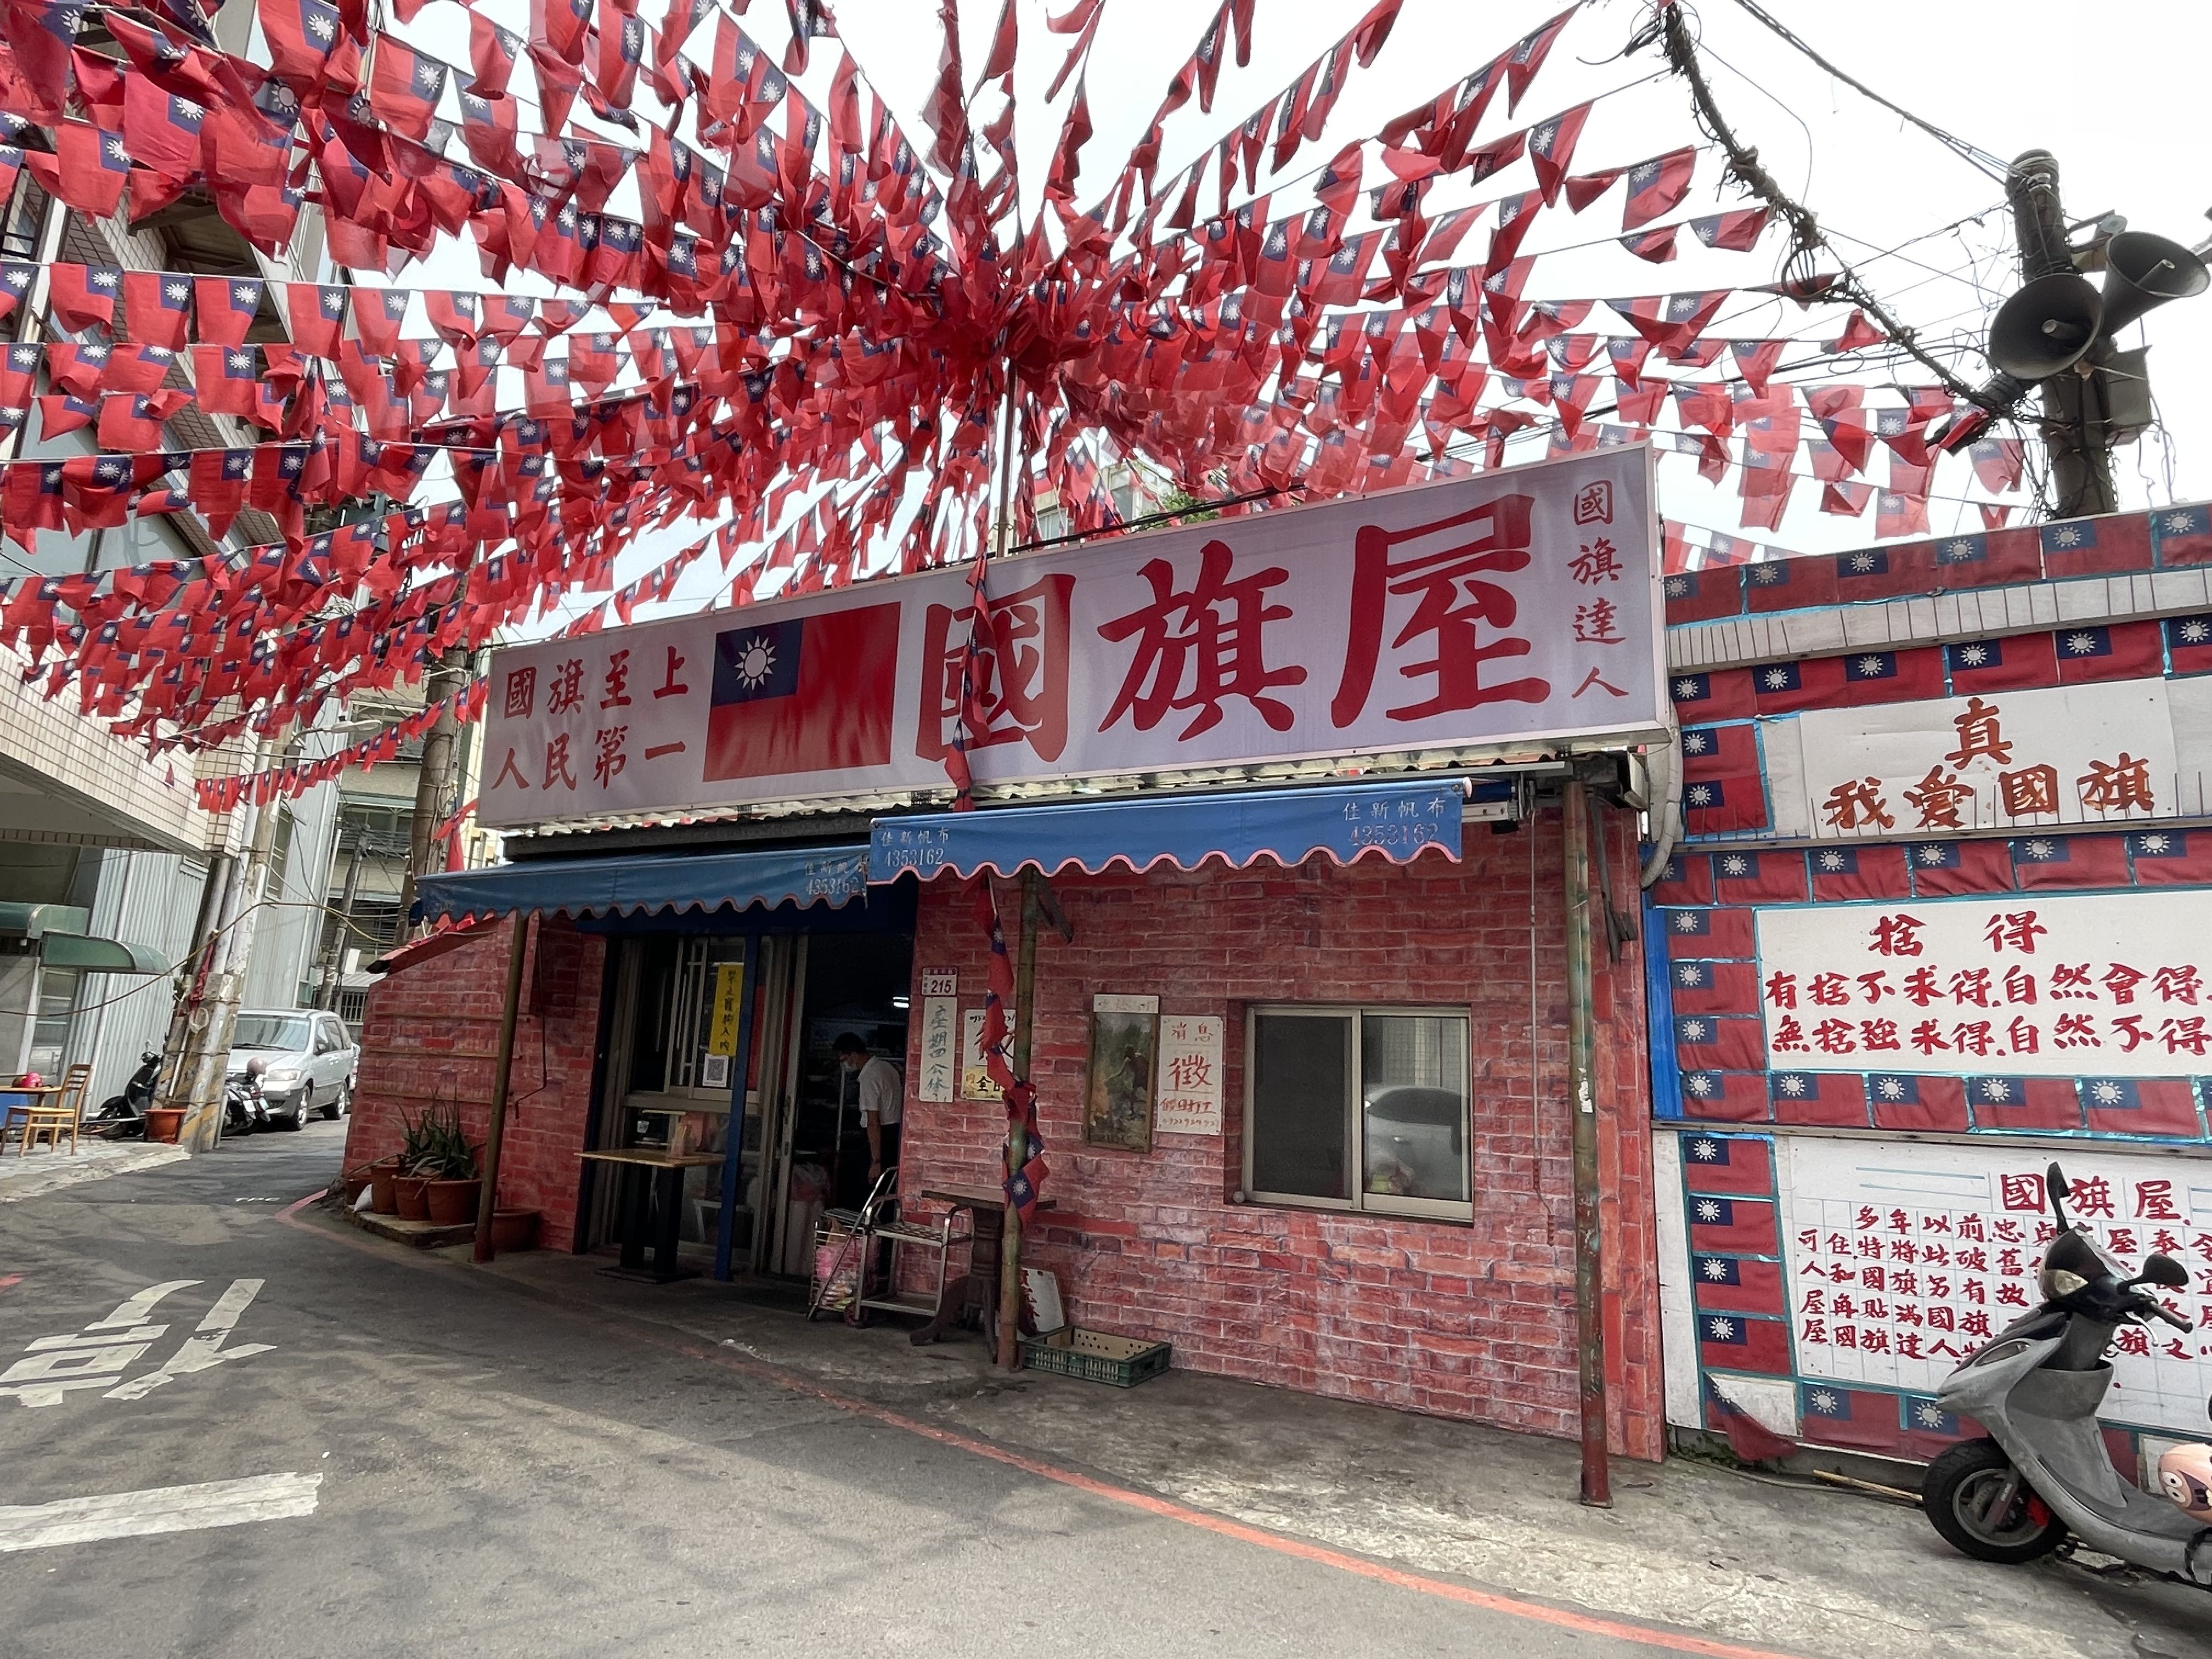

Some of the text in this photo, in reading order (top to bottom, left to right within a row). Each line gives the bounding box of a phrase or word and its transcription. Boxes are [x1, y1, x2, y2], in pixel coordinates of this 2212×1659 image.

[1567, 479, 1629, 698] 國旗達人
[915, 493, 1551, 764] 國旗屋
[504, 645, 690, 720] 國旗至上
[1945, 697, 2013, 770] 真
[491, 726, 686, 793] 人民第一
[1342, 797, 1446, 821] 佳新帆布
[1822, 753, 2155, 830] 我愛國旗
[879, 826, 950, 847] 佳新帆布
[1348, 822, 1439, 846] 4353162
[884, 848, 944, 867] 4353162
[930, 979, 952, 994] 215
[1171, 1020, 1214, 1042] 消息
